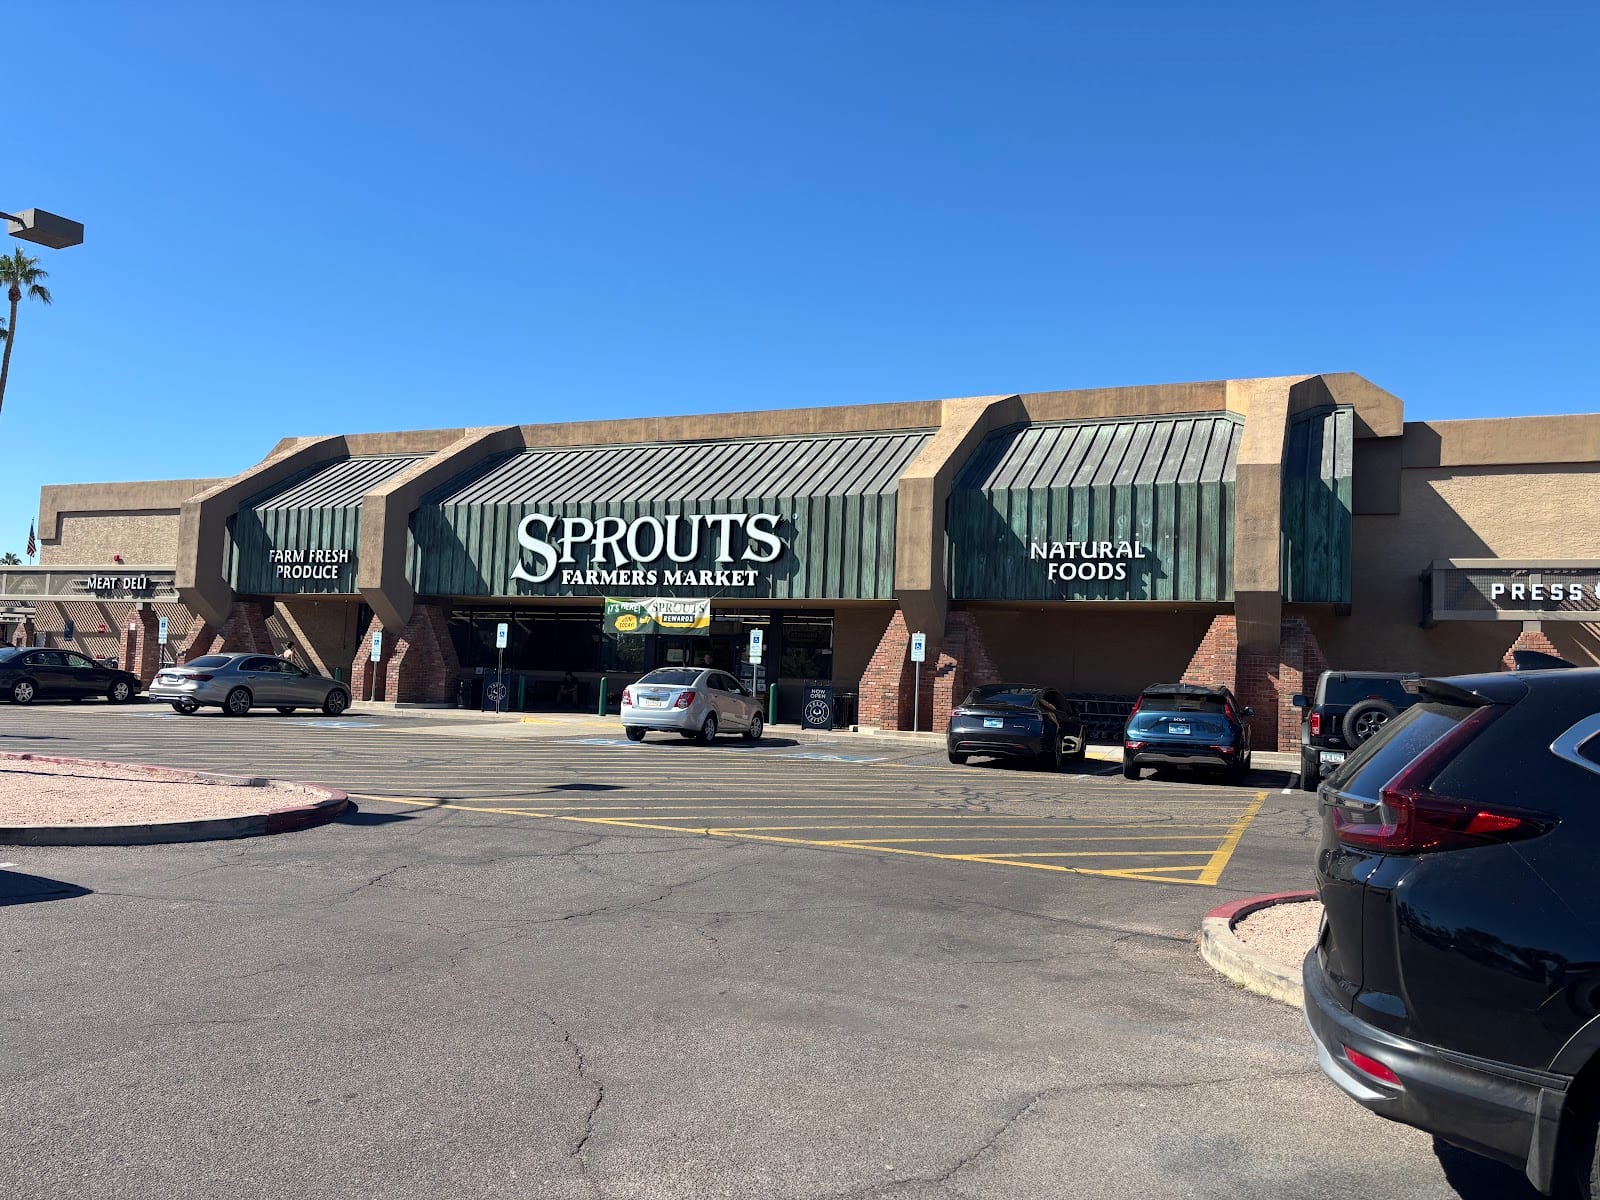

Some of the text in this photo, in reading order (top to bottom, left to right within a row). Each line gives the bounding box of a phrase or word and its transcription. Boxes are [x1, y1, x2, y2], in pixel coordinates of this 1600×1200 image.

[510, 513, 783, 583] SPROUTS
[1030, 541, 1146, 559] NATURAL
[269, 549, 349, 563] FARM FRESH
[276, 565, 339, 579] PRODUCE
[561, 570, 759, 586] FARMERS MARKET
[1048, 562, 1127, 580] FOODS
[87, 577, 147, 590] MEAT DELI
[1491, 583, 1583, 601] PRESS
[651, 602, 705, 613] SPROUTS
[663, 615, 694, 623] REWARDS
